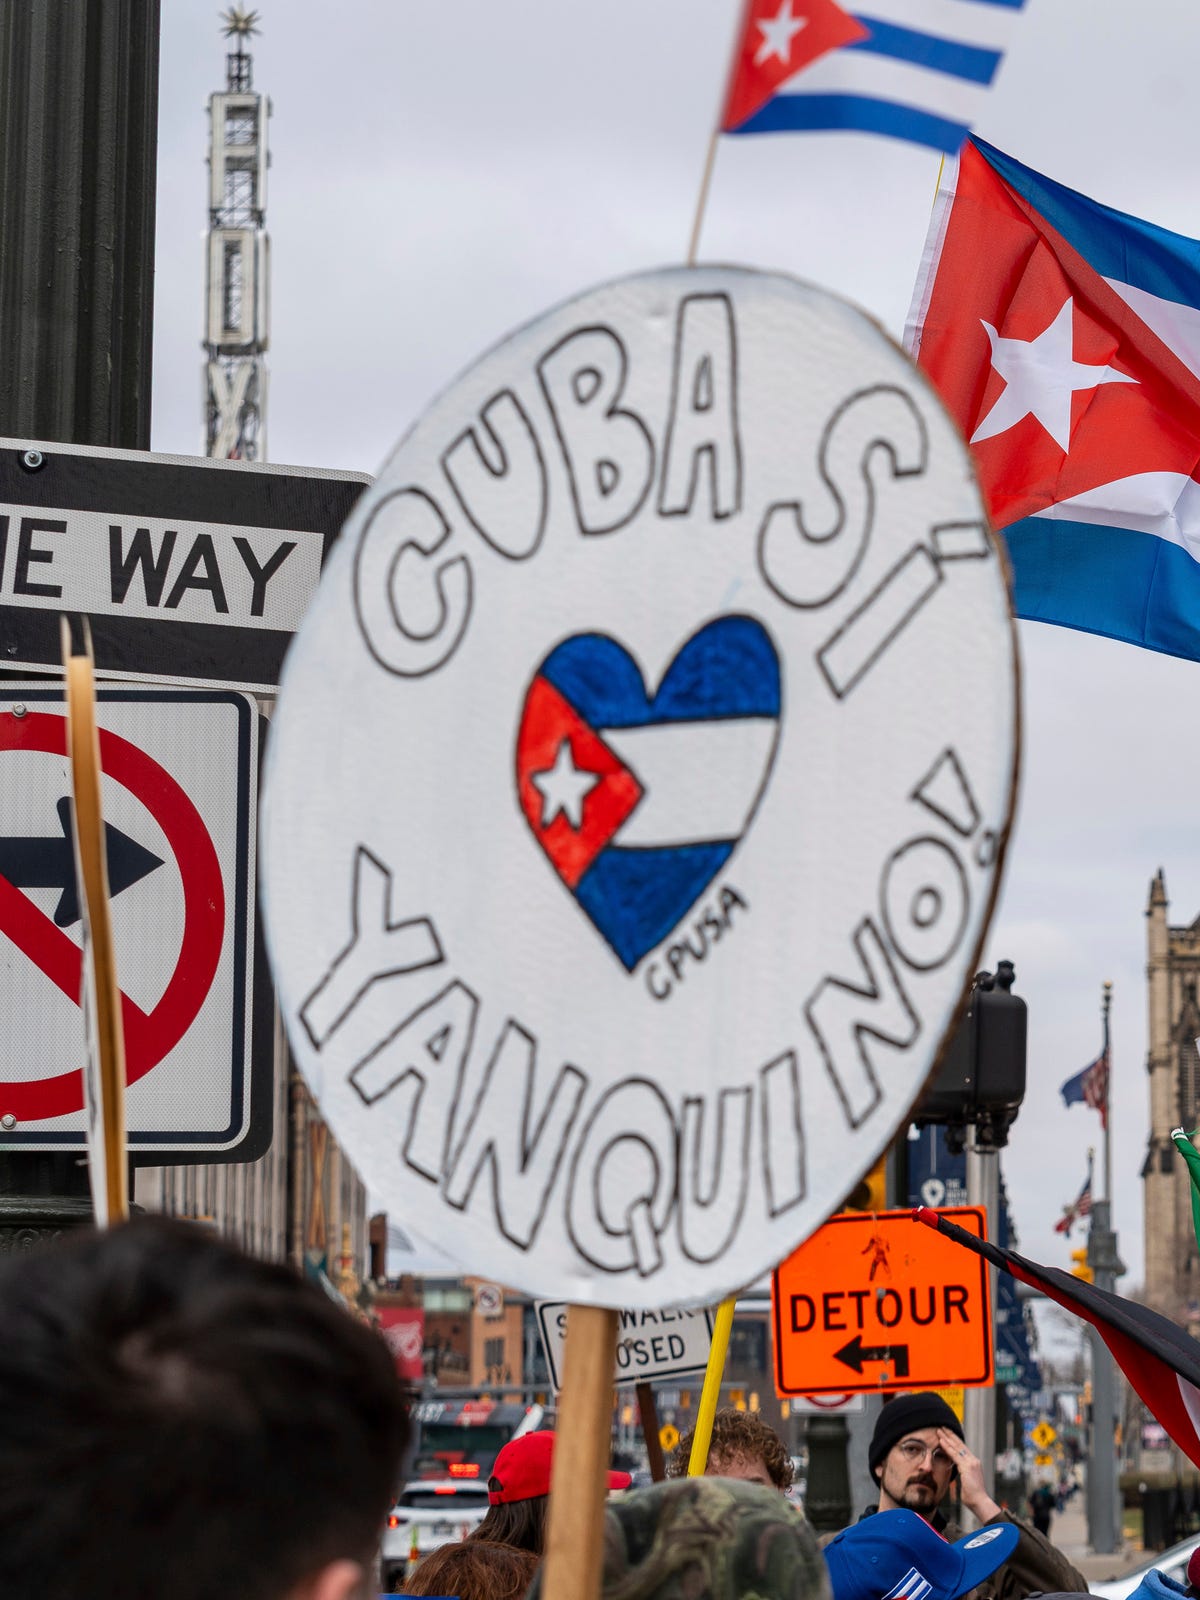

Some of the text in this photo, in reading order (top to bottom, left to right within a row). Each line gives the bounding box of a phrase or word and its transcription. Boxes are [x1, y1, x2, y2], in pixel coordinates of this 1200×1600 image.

[353, 291, 743, 680] CUBA
[109, 525, 298, 617] WAY
[645, 885, 748, 1001] CPUSA
[298, 745, 1003, 1278] YANQUI NO!
[790, 1285, 970, 1334] DETOUR
